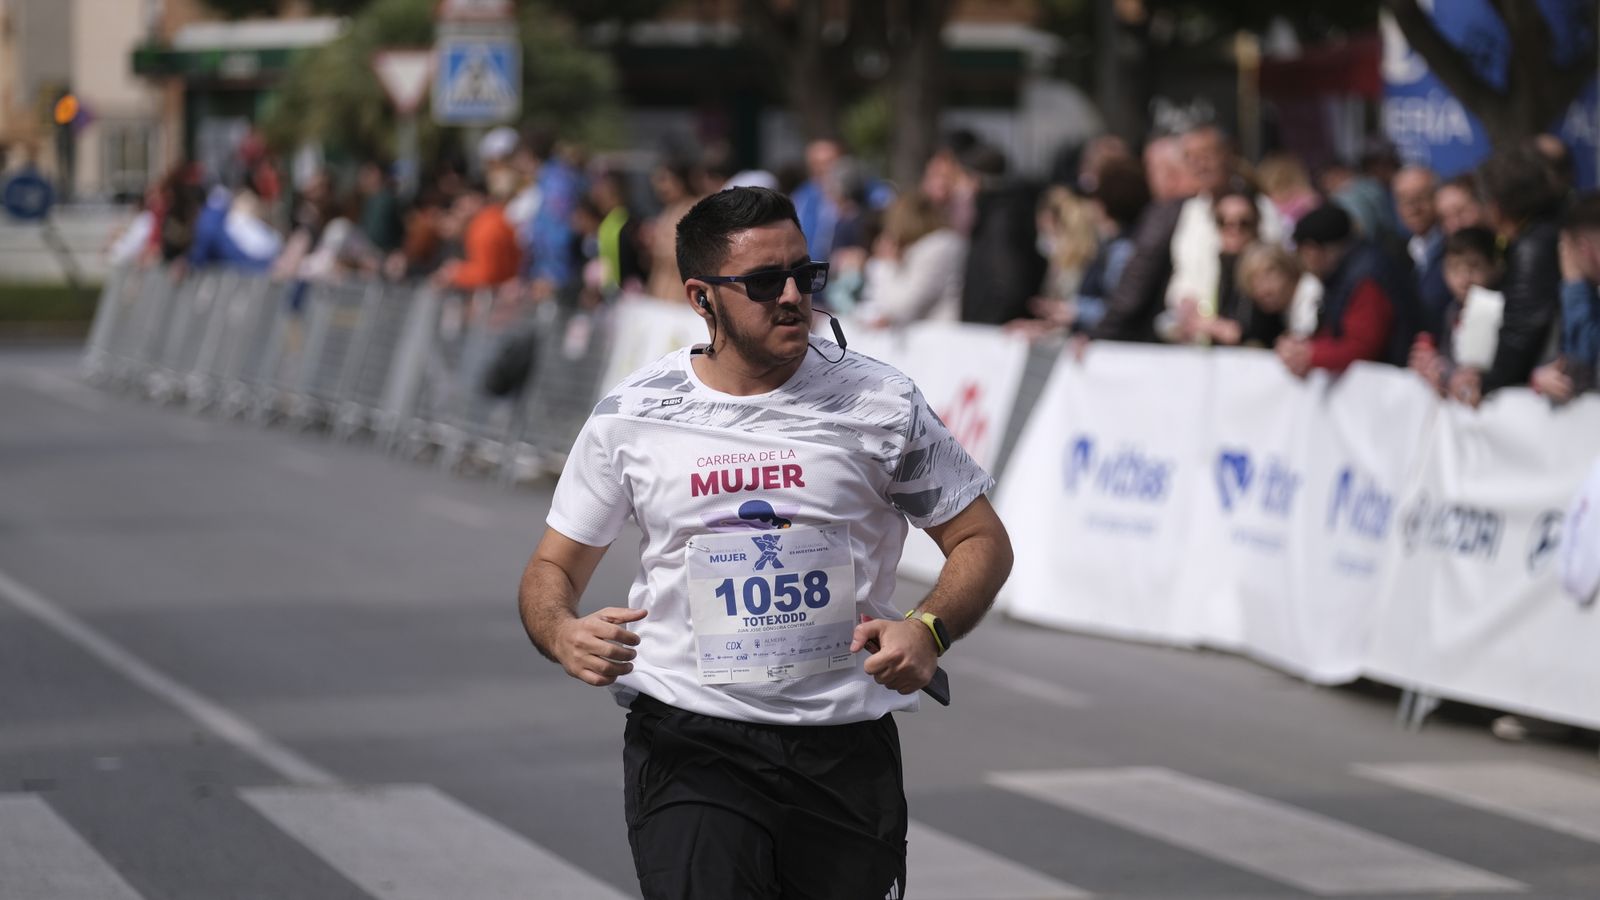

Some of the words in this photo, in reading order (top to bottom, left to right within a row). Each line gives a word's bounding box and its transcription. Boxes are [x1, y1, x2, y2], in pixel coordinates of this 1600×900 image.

[696, 453, 756, 467] CARRERA
[759, 451, 776, 461] DE
[780, 449, 796, 460] LA
[690, 463, 805, 497] MUJER
[709, 553, 747, 563] MUJER
[715, 570, 831, 616] 1058
[742, 612, 807, 627] TOTEXDDD
